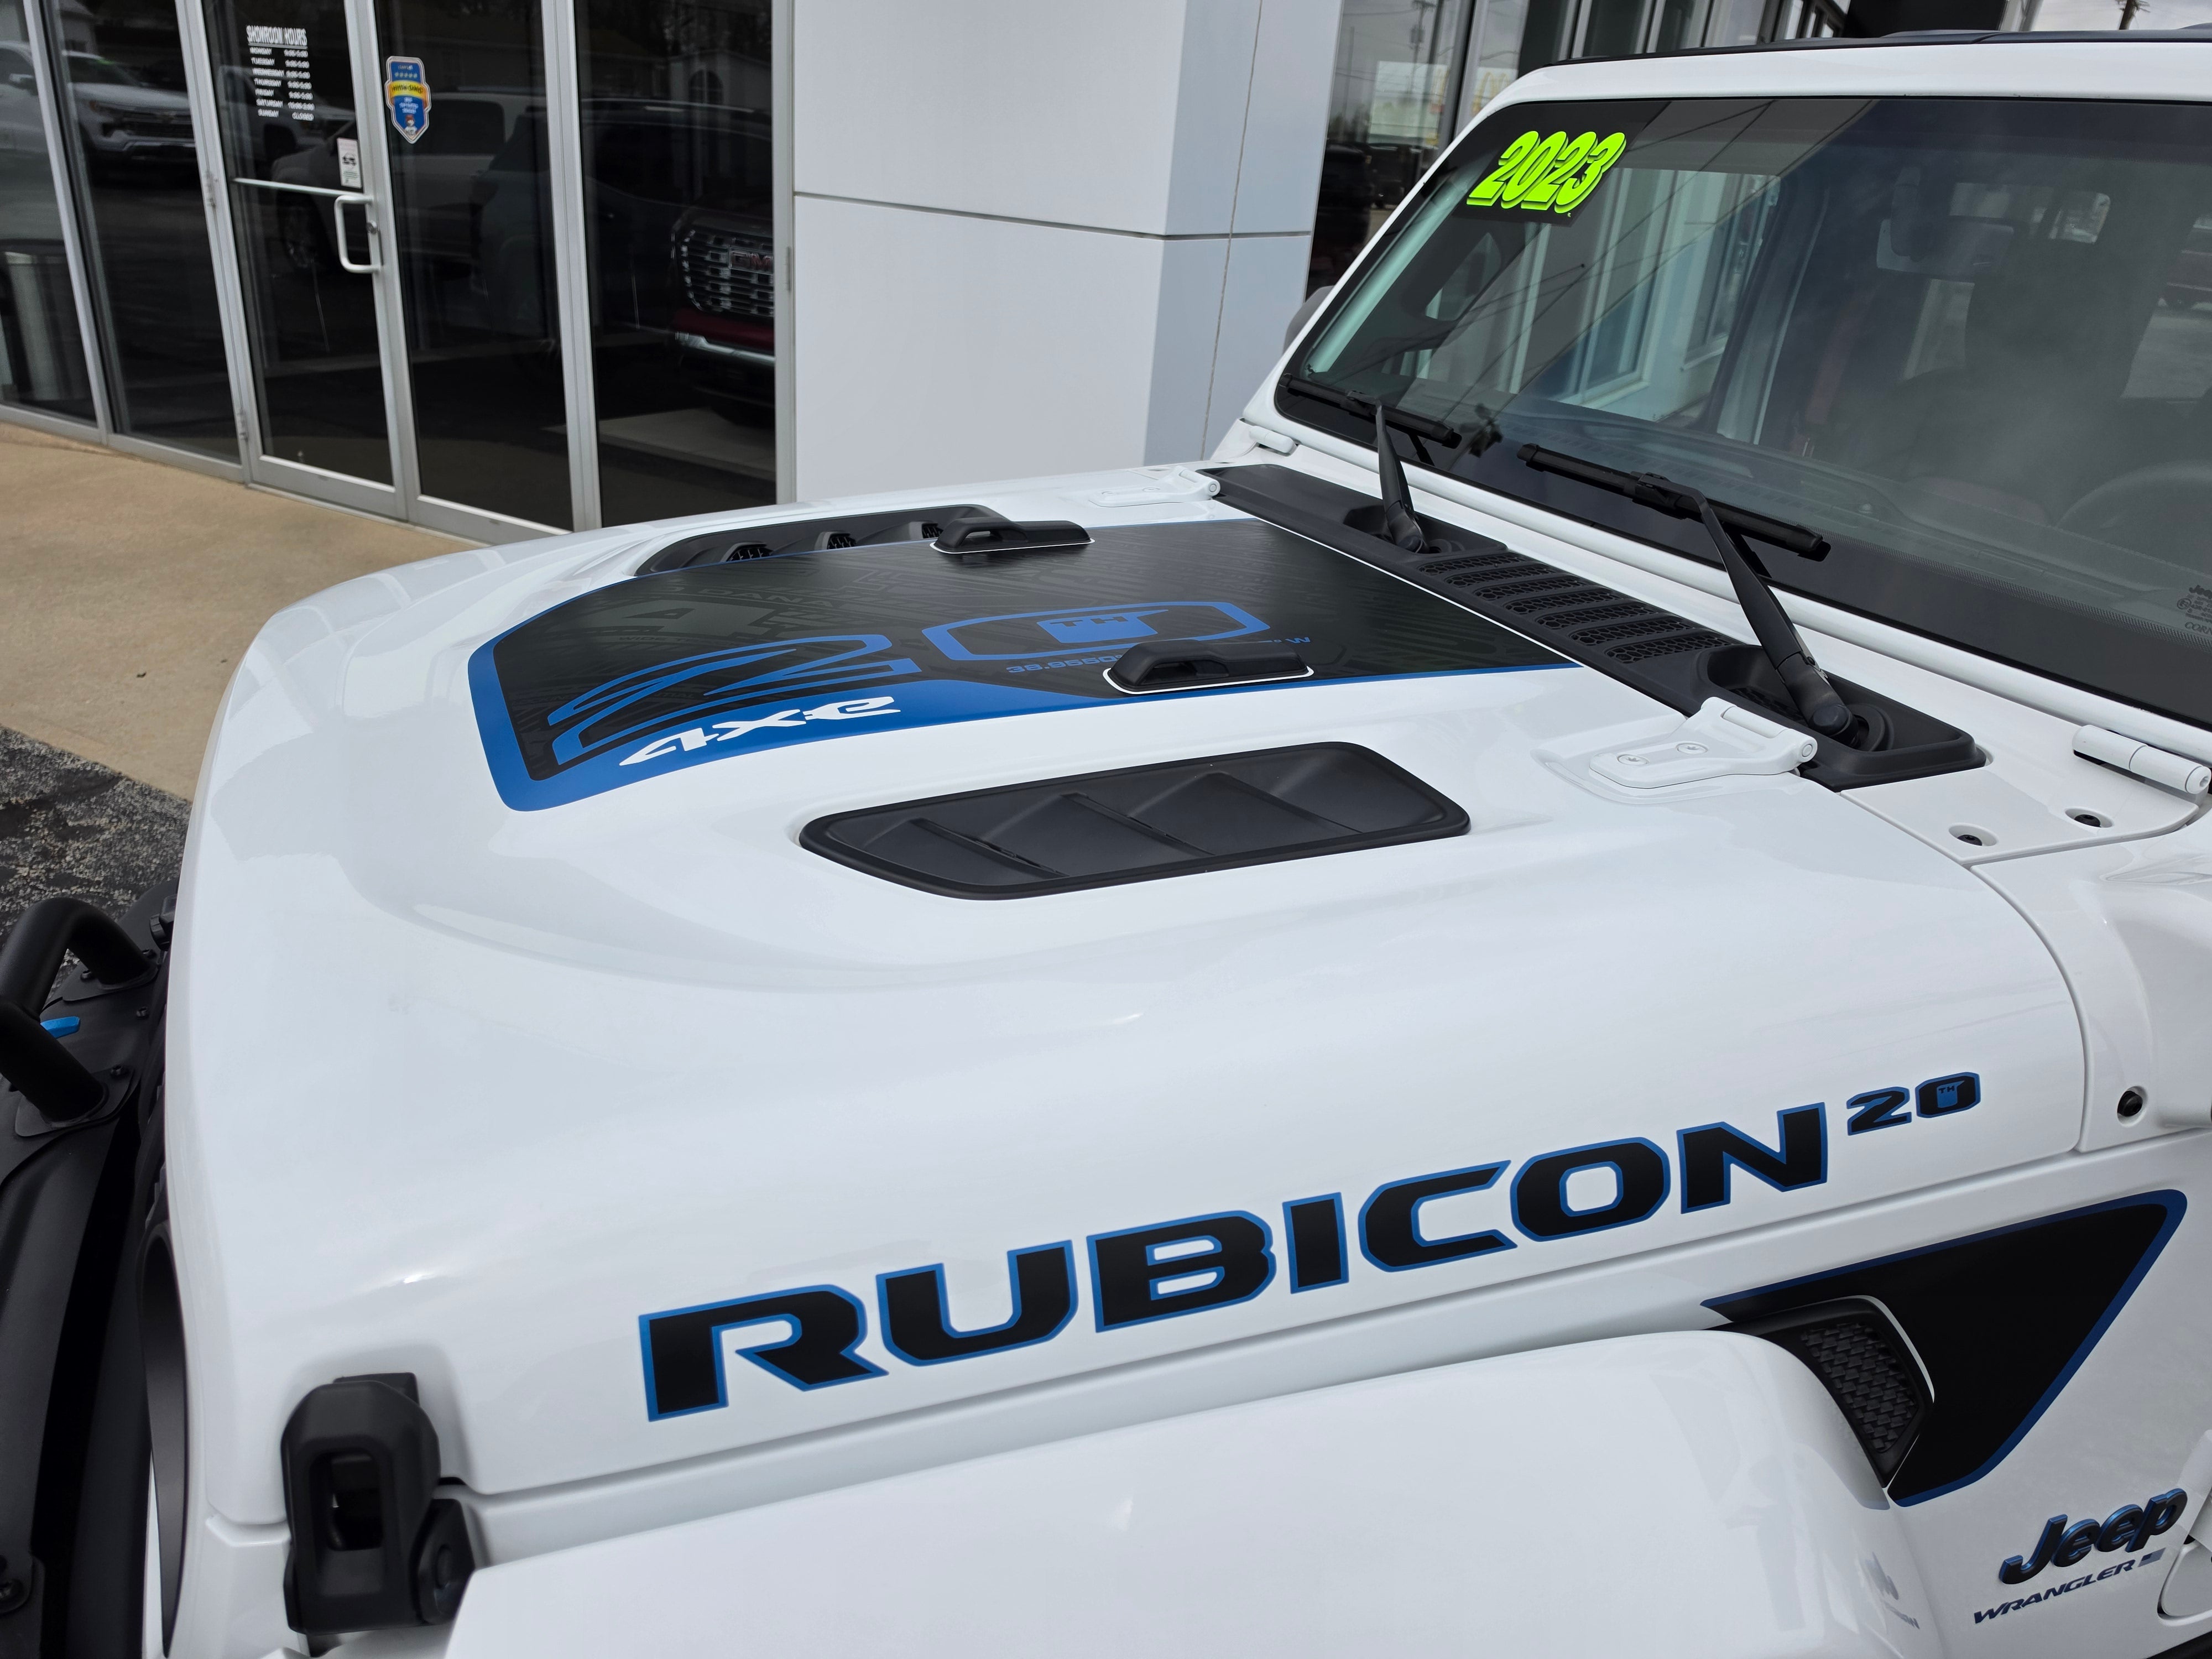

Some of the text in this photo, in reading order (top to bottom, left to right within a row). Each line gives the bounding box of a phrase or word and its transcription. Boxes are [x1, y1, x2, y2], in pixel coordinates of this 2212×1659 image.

[246, 25, 307, 46] SHOWROOM HOURS
[251, 57, 275, 66] TUESDAY
[252, 68, 284, 77] WEDNESDAY
[254, 78, 281, 87] THURSDAY
[255, 88, 274, 97] FRIDAY
[256, 98, 283, 108] SATURDAY
[258, 108, 314, 121] SUNDAY CLOSED
[1467, 131, 1626, 213] 2023
[638, 1072, 1981, 1422] RUBICON 20
[1999, 1488, 2188, 1584] Jeep
[1974, 1558, 2136, 1624] WRANGLER
